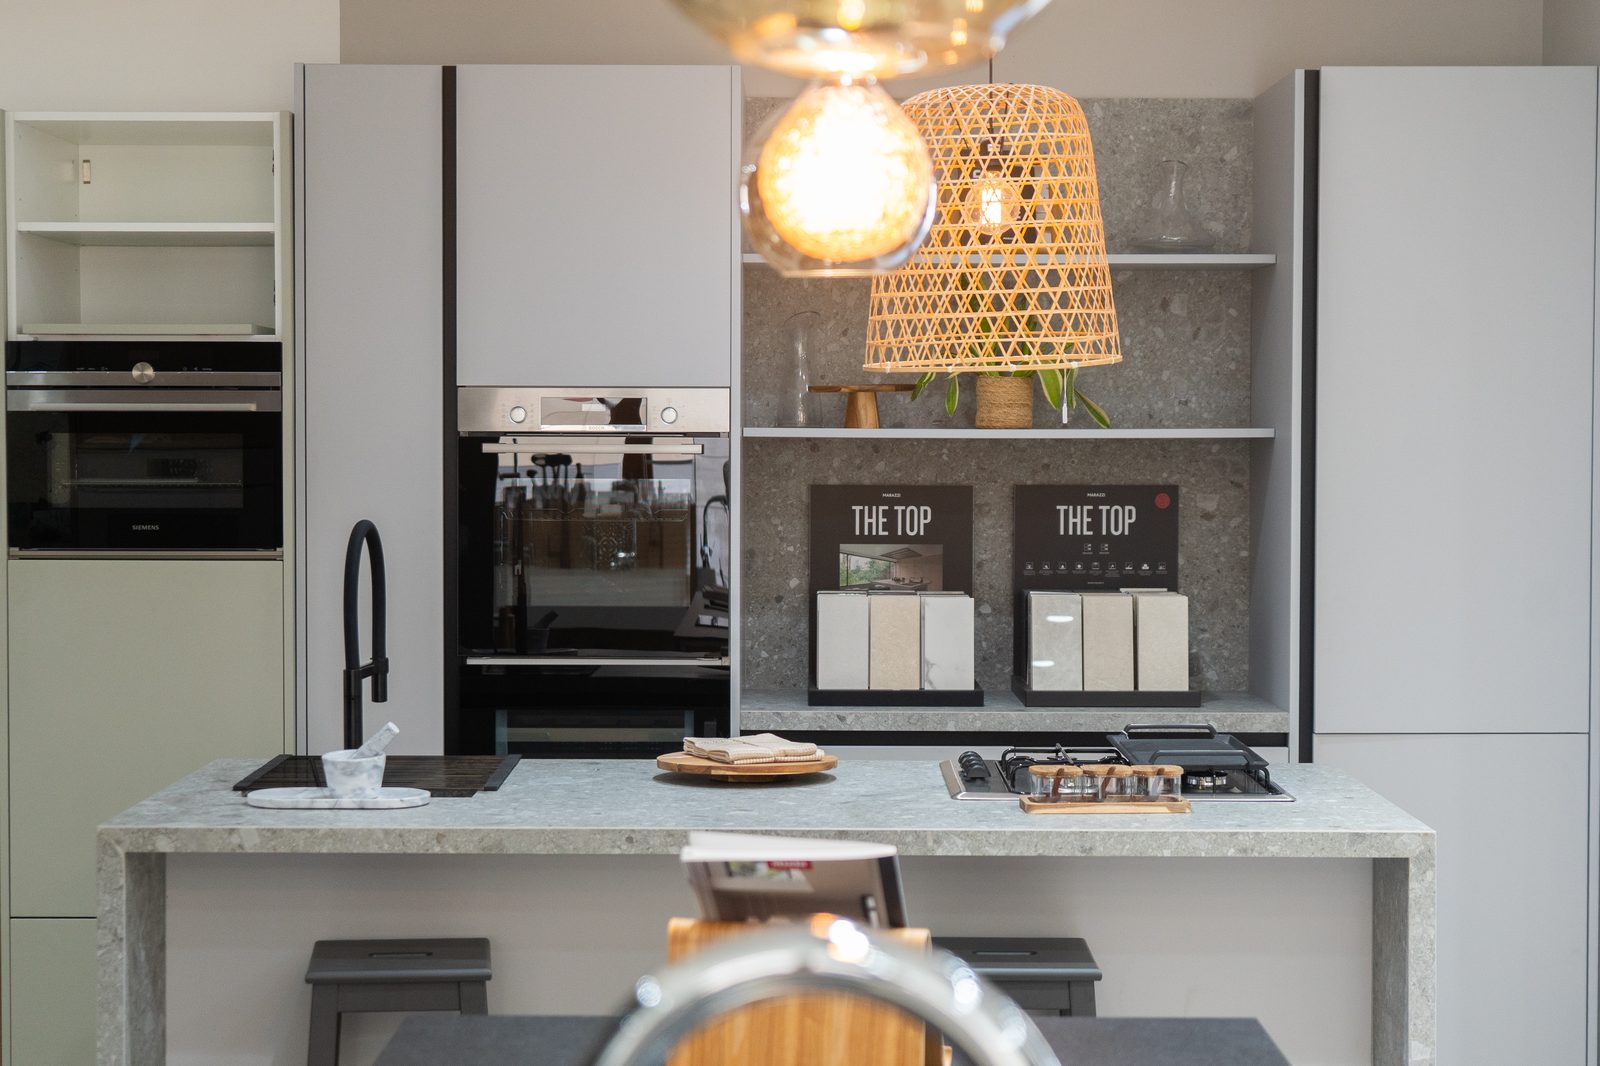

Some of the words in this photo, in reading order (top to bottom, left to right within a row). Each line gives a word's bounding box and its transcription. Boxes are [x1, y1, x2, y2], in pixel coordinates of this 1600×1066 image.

[851, 506, 888, 536] THE
[893, 506, 932, 536] TOP
[1056, 505, 1093, 536] THE
[1098, 505, 1137, 536] TOP
